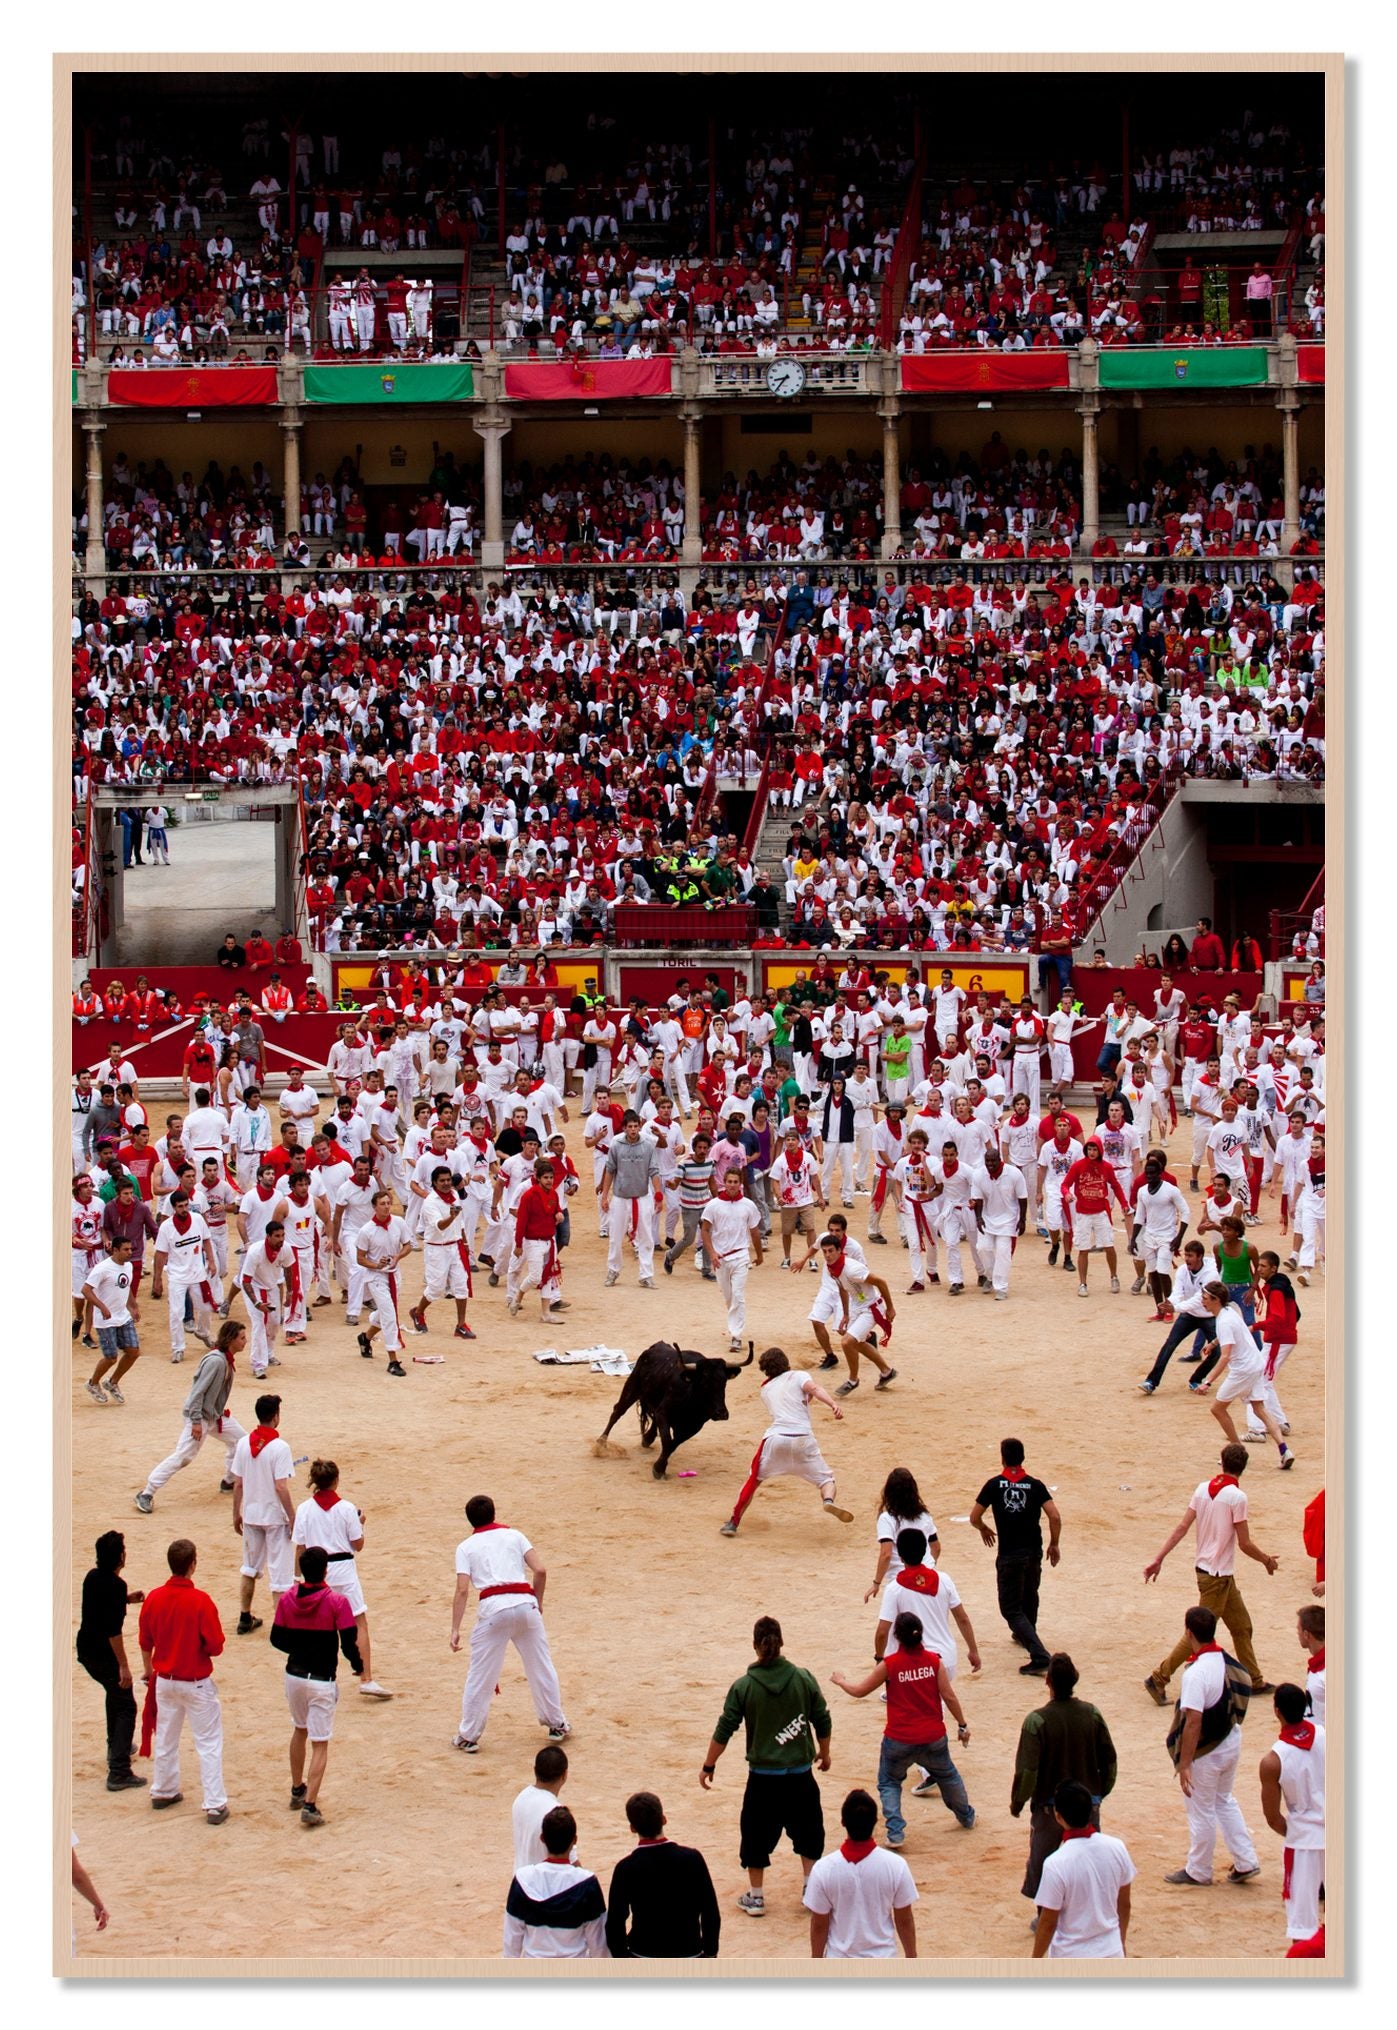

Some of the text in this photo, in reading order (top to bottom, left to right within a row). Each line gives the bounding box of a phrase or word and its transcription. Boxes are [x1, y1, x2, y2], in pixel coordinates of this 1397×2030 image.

[662, 959, 697, 967] TORIL
[969, 974, 984, 991] 6
[898, 1665, 935, 1683] GALLEGA
[774, 1713, 807, 1745] INEFC
